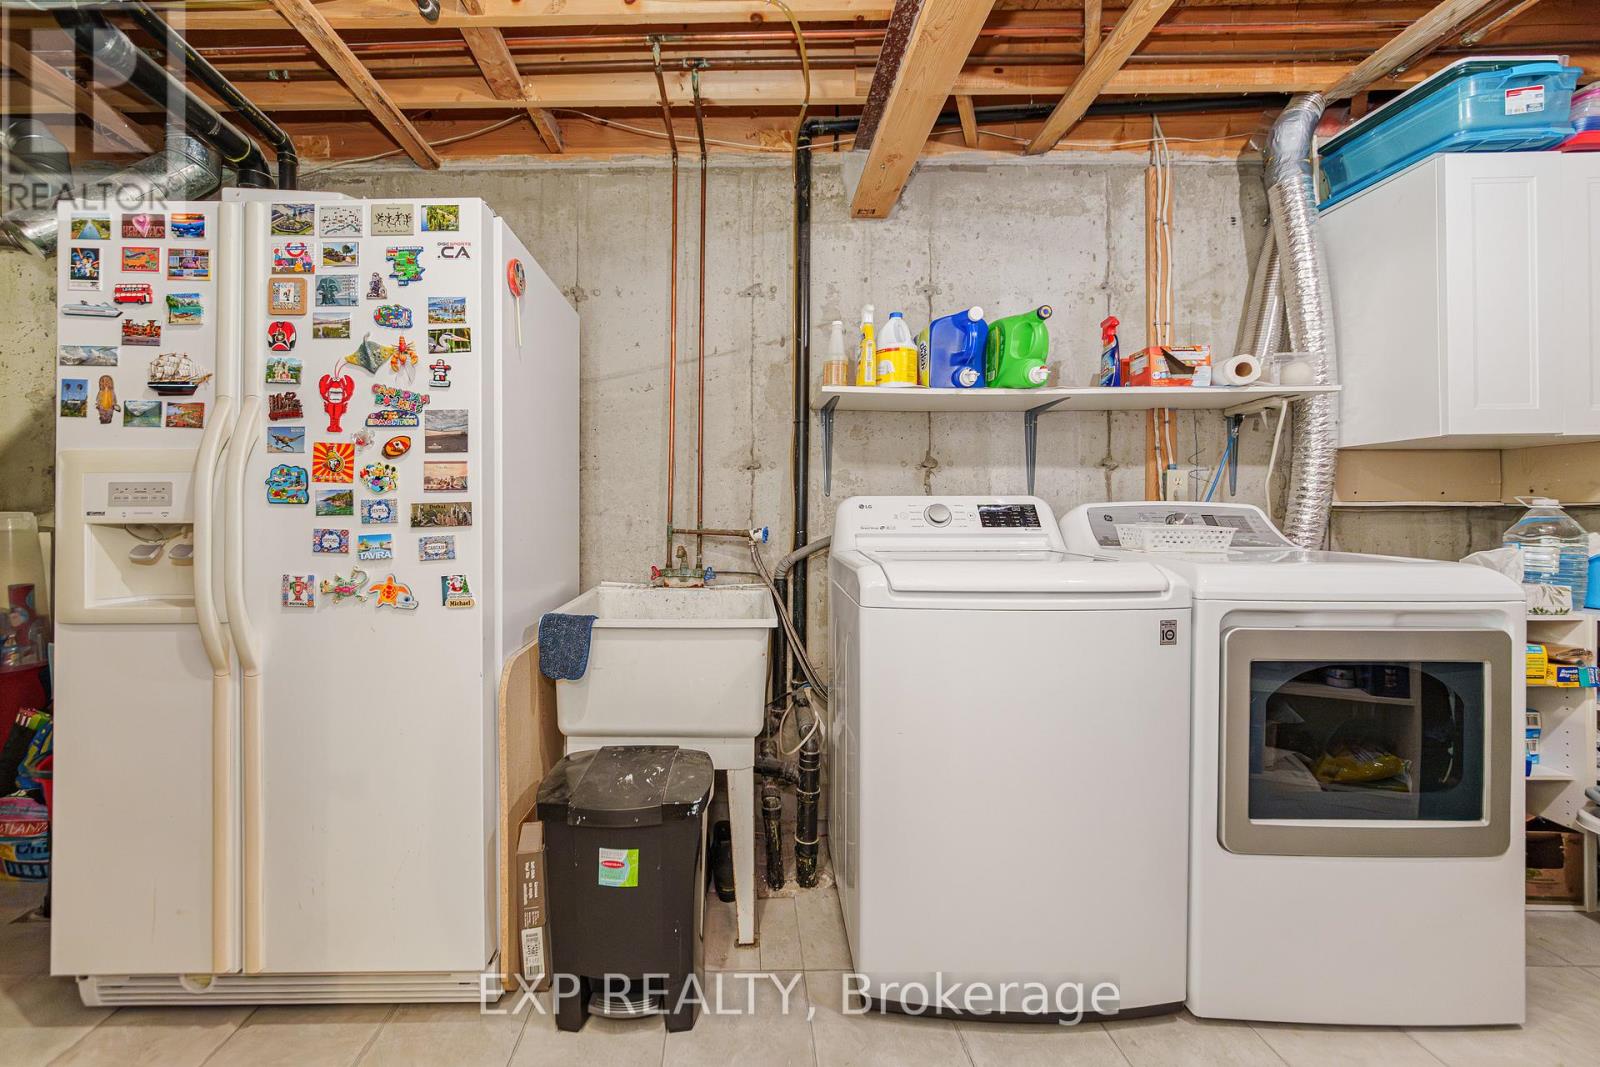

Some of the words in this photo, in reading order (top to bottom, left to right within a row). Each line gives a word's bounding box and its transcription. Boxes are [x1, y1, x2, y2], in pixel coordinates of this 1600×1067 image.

[367, 418, 417, 426] EDMONTON
[359, 551, 392, 560] TAVIRA
[449, 599, 471, 607] Michael
